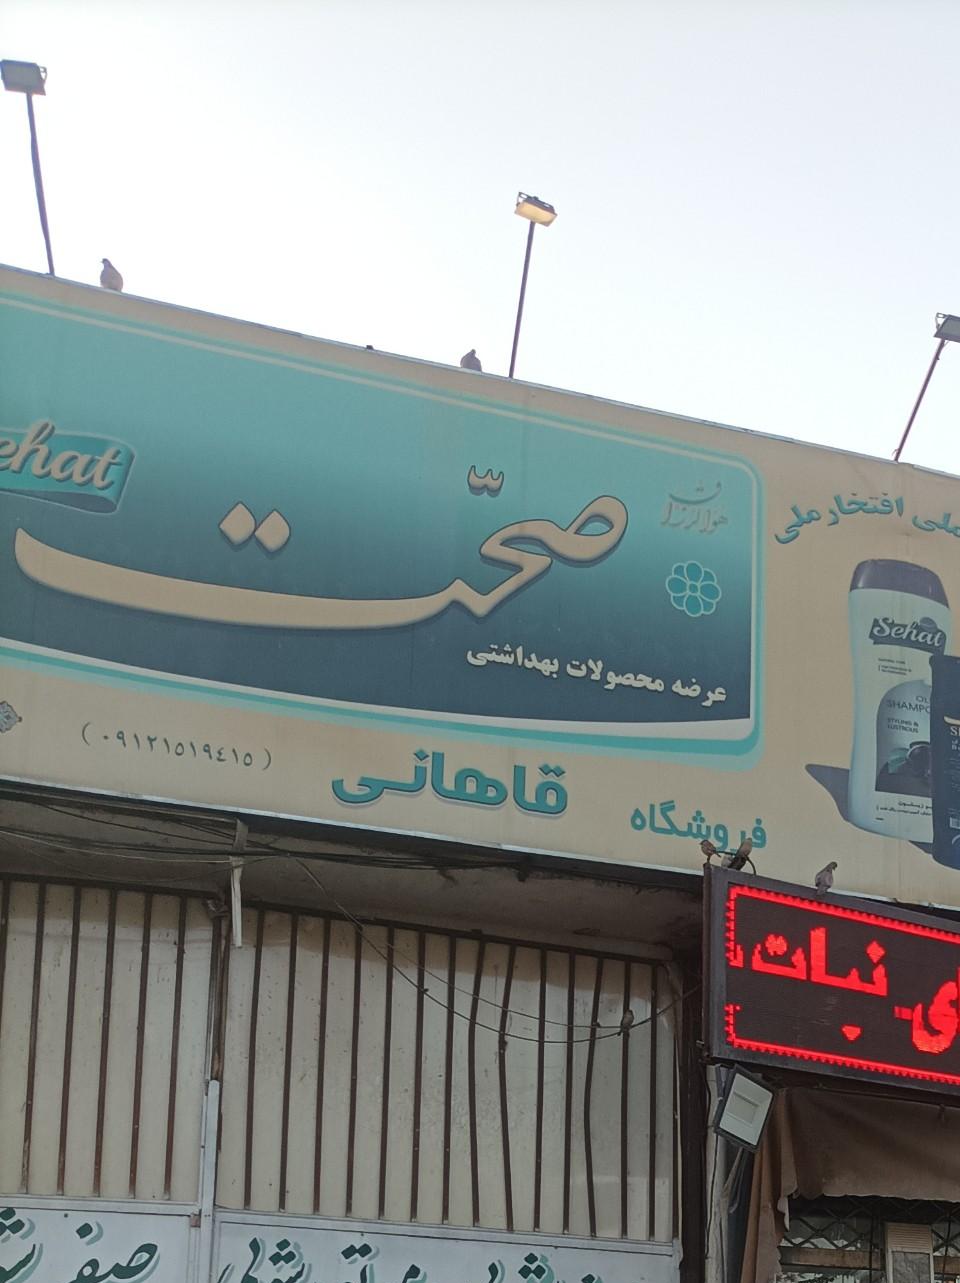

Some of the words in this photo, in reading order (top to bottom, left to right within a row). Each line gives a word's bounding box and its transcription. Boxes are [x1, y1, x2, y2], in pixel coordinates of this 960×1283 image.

[0, 418, 122, 491] ehat
[774, 504, 822, 545] ملی
[827, 492, 904, 527] افتخار
[466, 642, 559, 679] بهداشتی
[566, 658, 665, 693] محصولات
[671, 677, 727, 707] عرضه
[331, 748, 569, 817] قاهانی
